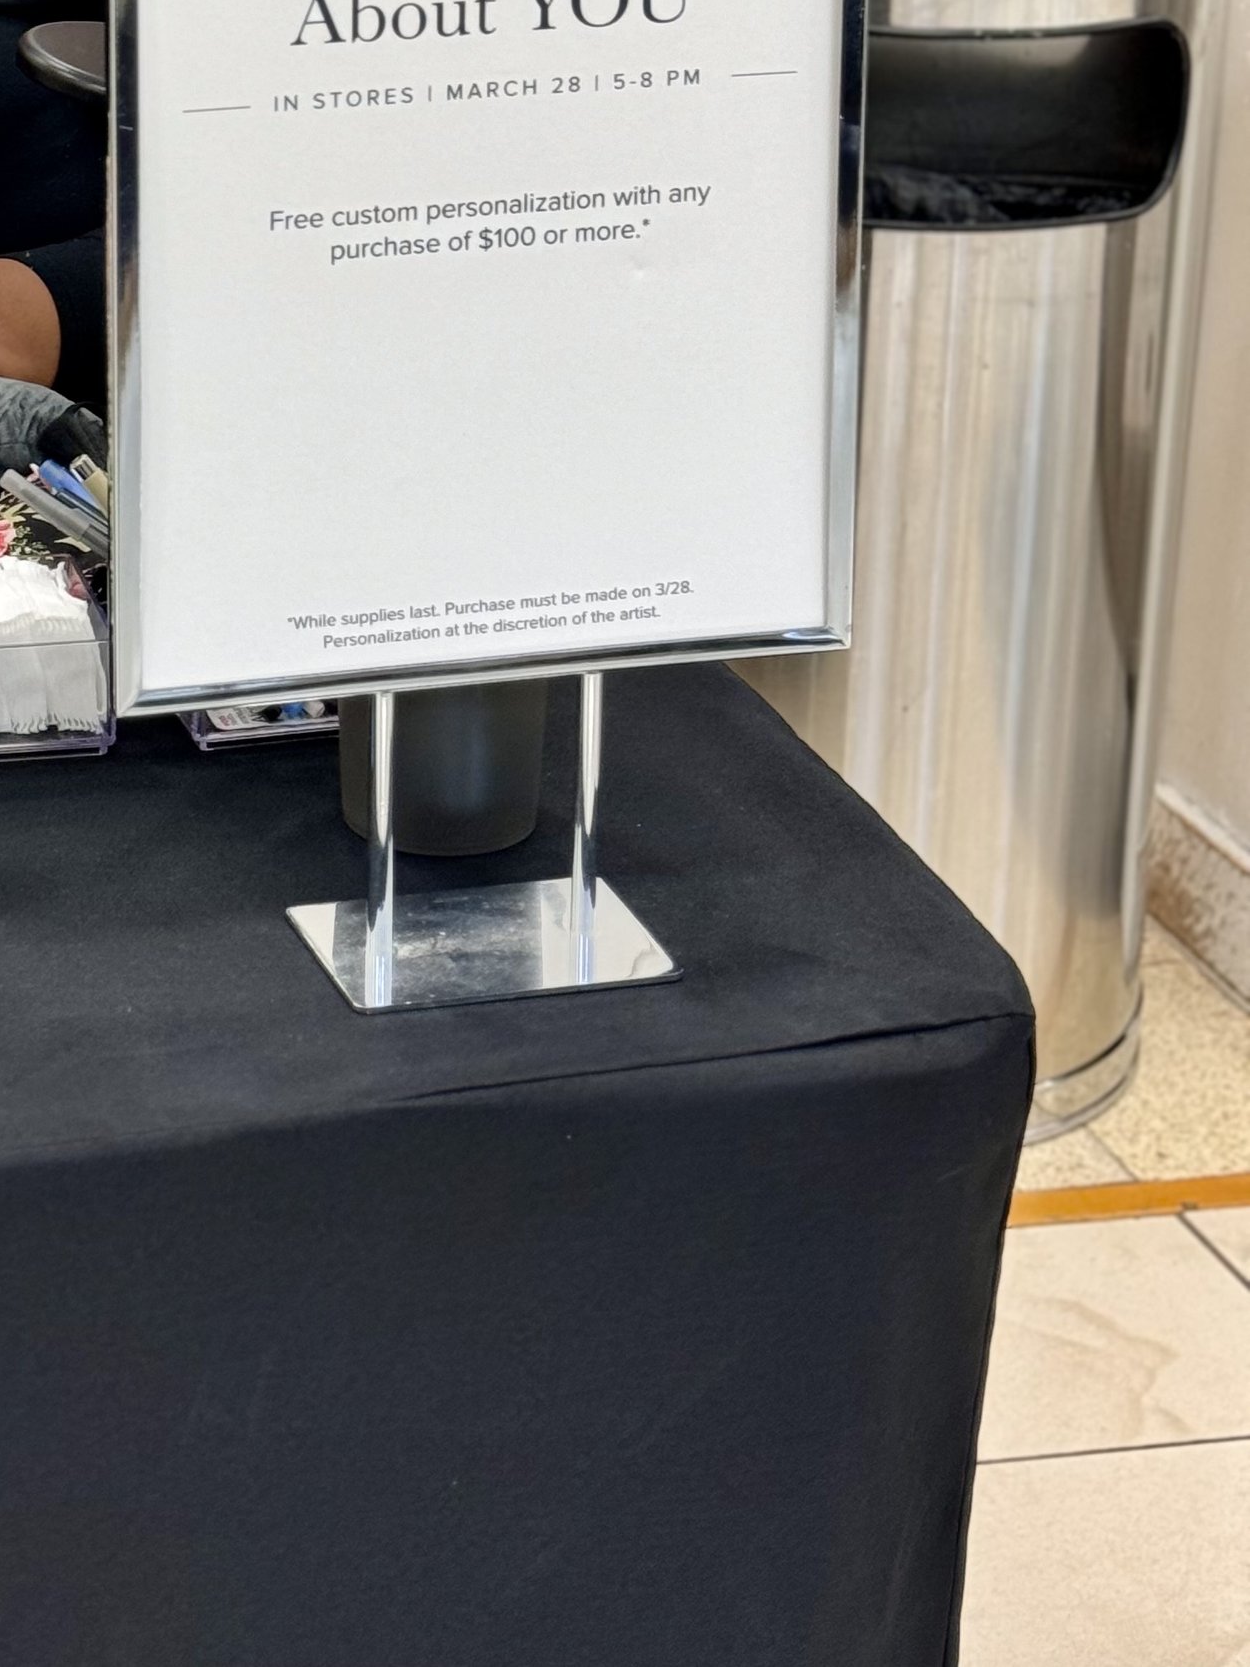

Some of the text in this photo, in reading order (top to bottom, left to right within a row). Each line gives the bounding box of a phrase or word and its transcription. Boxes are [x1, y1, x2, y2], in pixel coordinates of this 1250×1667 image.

[274, 94, 299, 112] IN
[312, 86, 414, 110] STORES
[446, 79, 537, 101] MARCH
[551, 75, 581, 94] 28
[613, 71, 653, 90] 5-8
[666, 68, 700, 87] PM
[269, 184, 712, 232] Free custom personalization with any
[330, 236, 441, 266] purchase
[447, 229, 474, 252] of
[478, 225, 536, 252] $100
[543, 228, 569, 245] or
[340, 608, 406, 628] supplies
[409, 604, 441, 619] last.
[444, 599, 516, 616] Purchase
[519, 593, 558, 610] must
[560, 591, 581, 606] be
[585, 586, 628, 603] made
[631, 586, 652, 599] on
[654, 580, 695, 597] 3/28.
[322, 605, 662, 649] Personalization at the discretion of the artist.
